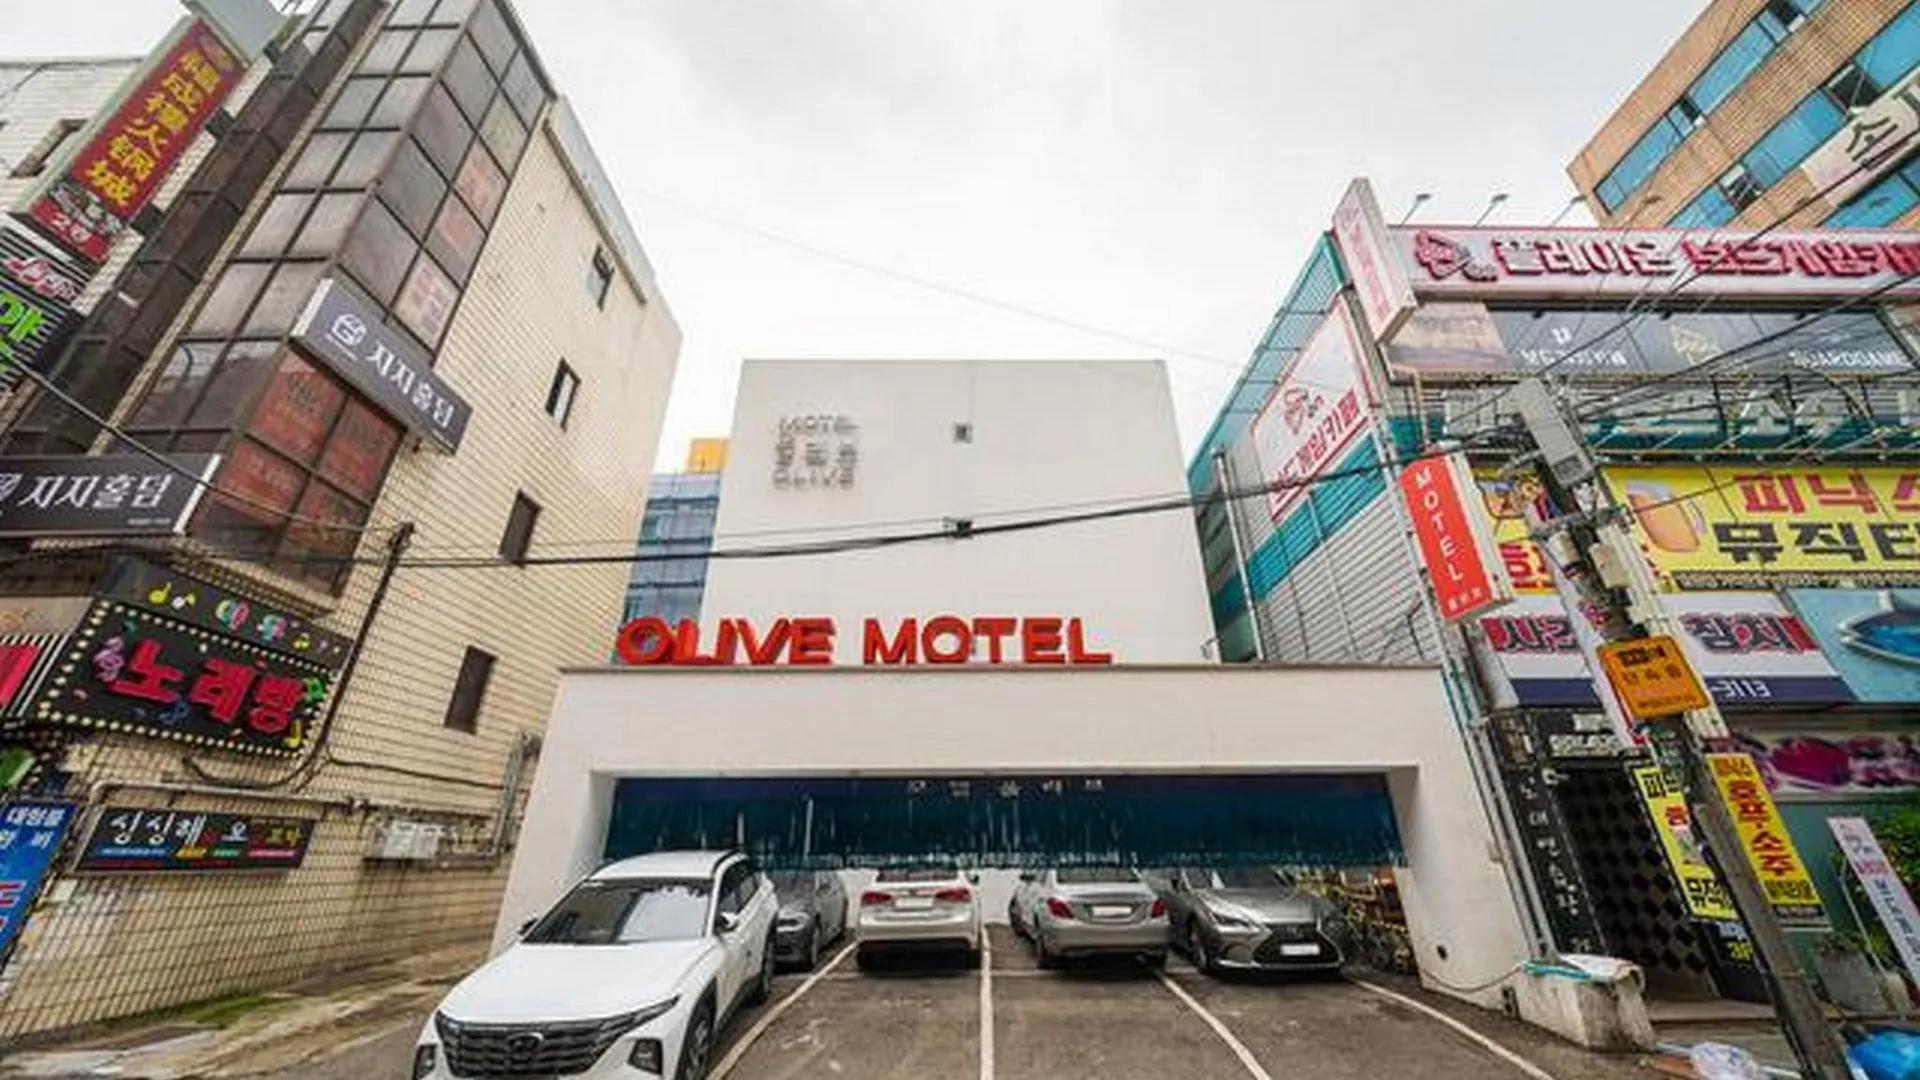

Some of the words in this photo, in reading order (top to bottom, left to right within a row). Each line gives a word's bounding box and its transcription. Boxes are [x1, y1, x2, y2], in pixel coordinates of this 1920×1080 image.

[1490, 238, 1678, 277] 플레이온
[17, 474, 172, 508] 지지홀덤
[1414, 466, 1465, 582] MOTEL
[615, 616, 837, 665] OLIVE
[863, 616, 1112, 665] MOTEL
[110, 640, 303, 732] 노래방
